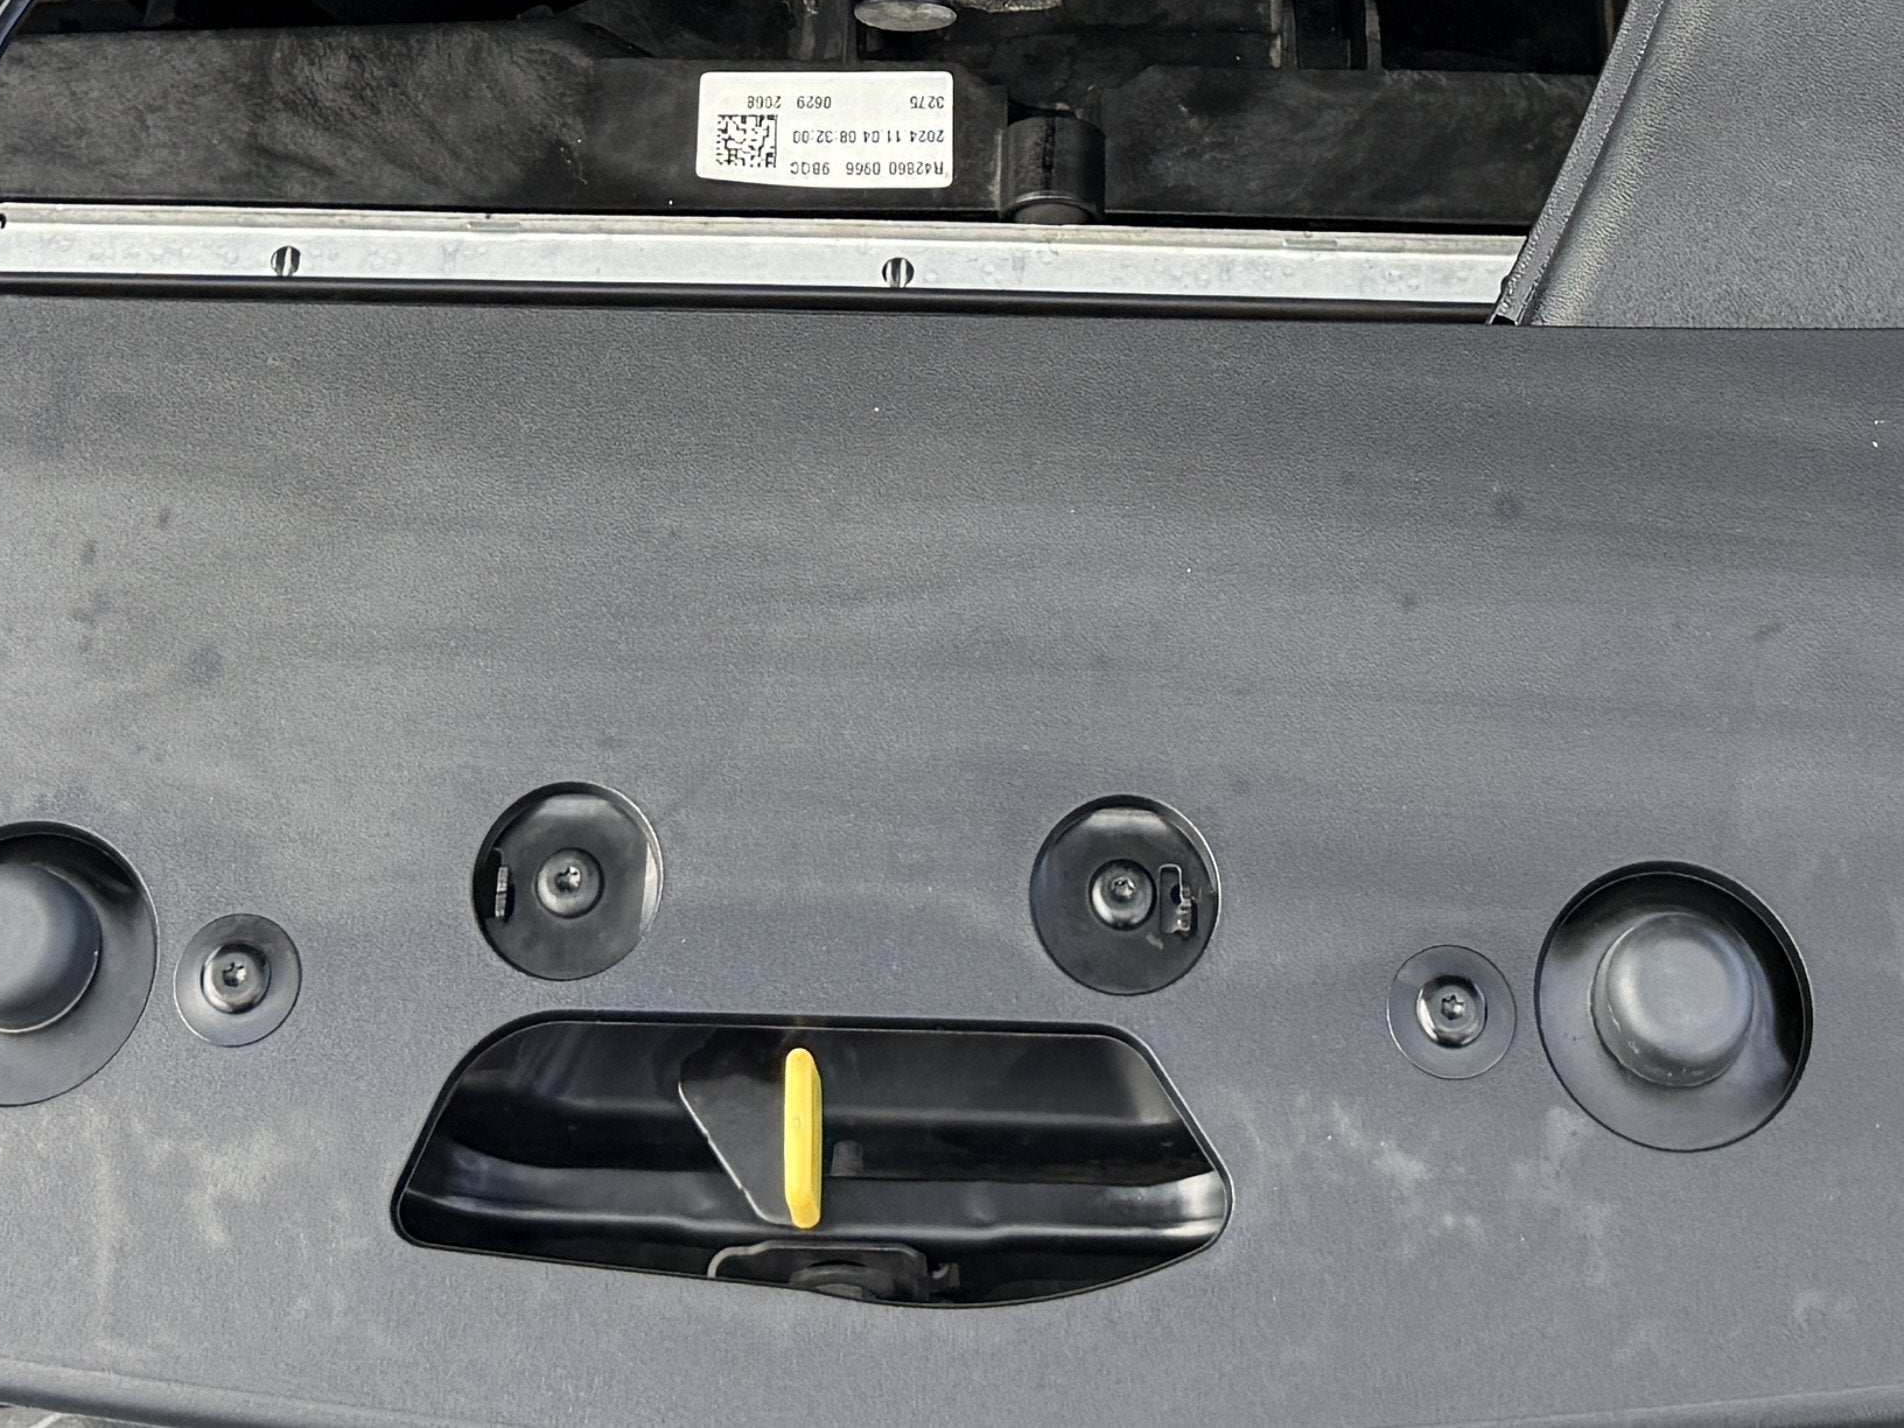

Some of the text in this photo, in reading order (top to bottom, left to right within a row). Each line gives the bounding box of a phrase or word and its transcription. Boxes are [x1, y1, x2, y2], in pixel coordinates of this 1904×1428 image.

[796, 95, 832, 109] 0629
[909, 96, 945, 109] 3275
[792, 130, 857, 144] 08:32:00
[846, 161, 881, 175] 0966
